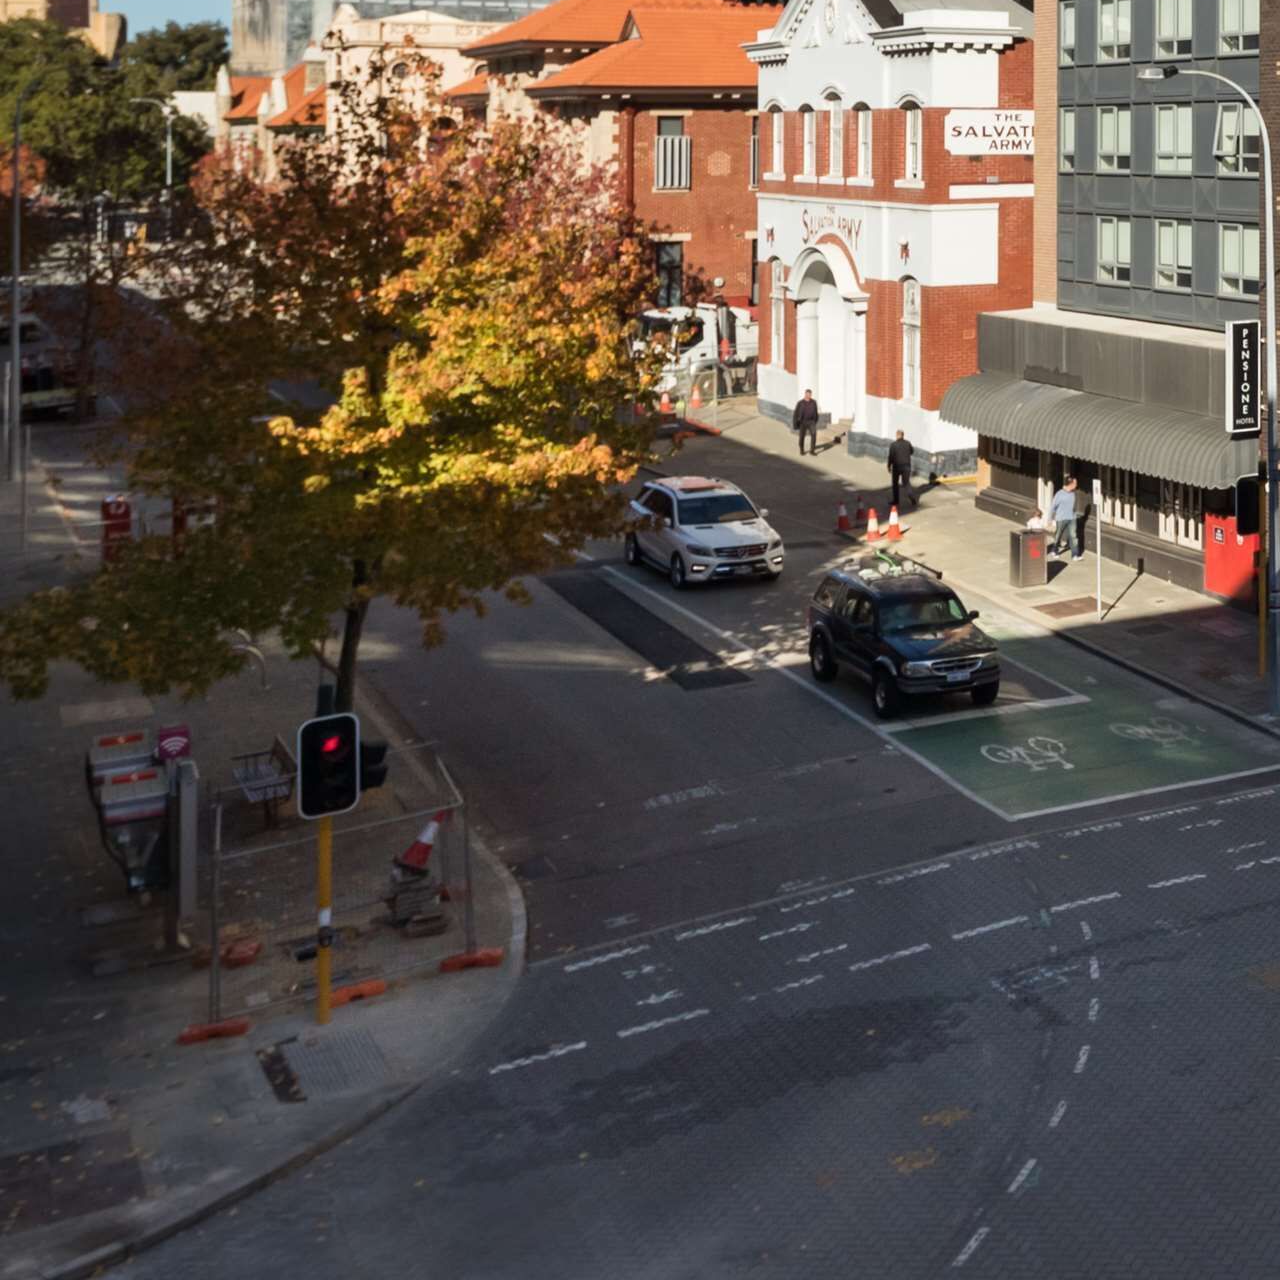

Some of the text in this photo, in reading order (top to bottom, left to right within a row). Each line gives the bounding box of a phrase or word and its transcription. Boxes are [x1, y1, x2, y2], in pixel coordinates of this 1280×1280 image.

[994, 113, 1022, 122] THE
[988, 139, 1032, 151] ARMY
[1241, 328, 1250, 415] PENSIONE
[1235, 417, 1255, 425] HOTEL
